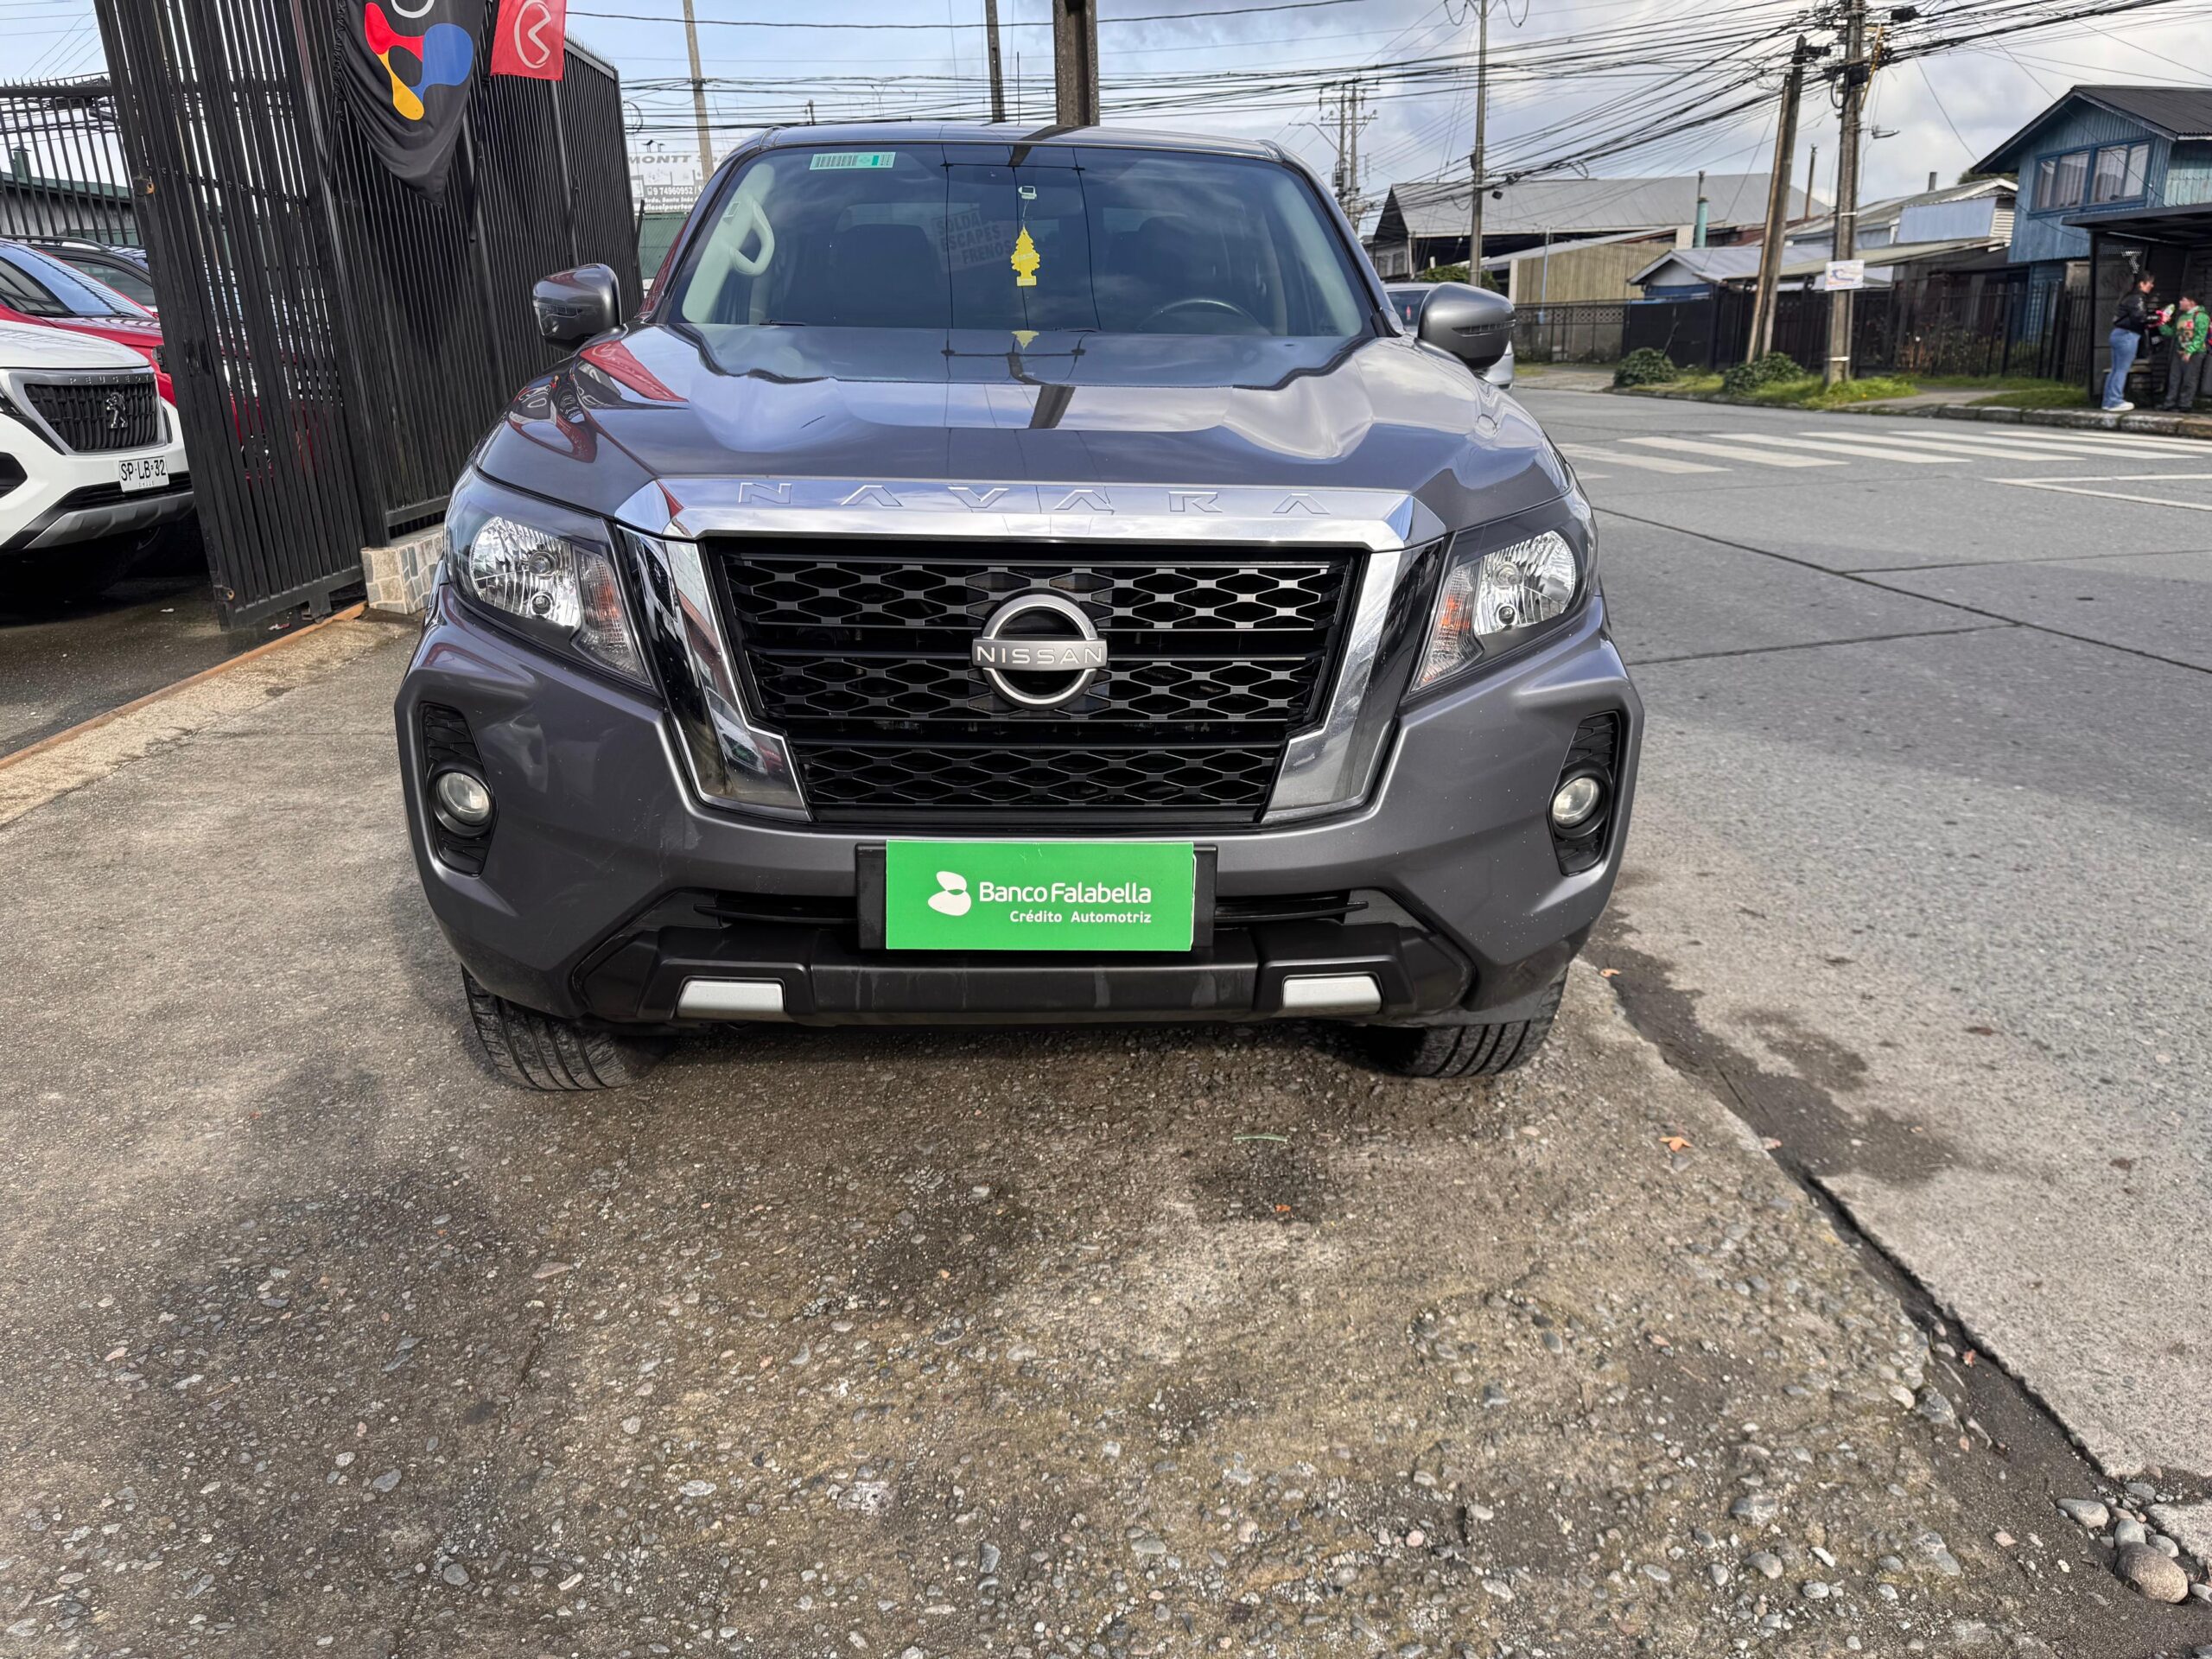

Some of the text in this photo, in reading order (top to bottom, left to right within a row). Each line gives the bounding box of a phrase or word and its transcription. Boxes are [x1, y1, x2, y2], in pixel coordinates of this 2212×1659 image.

[659, 186, 693, 195] 74960952
[738, 481, 1332, 515] NAVARA
[976, 645, 1103, 665] NISSAN
[1009, 910, 1152, 924] Crédito Automotriz
